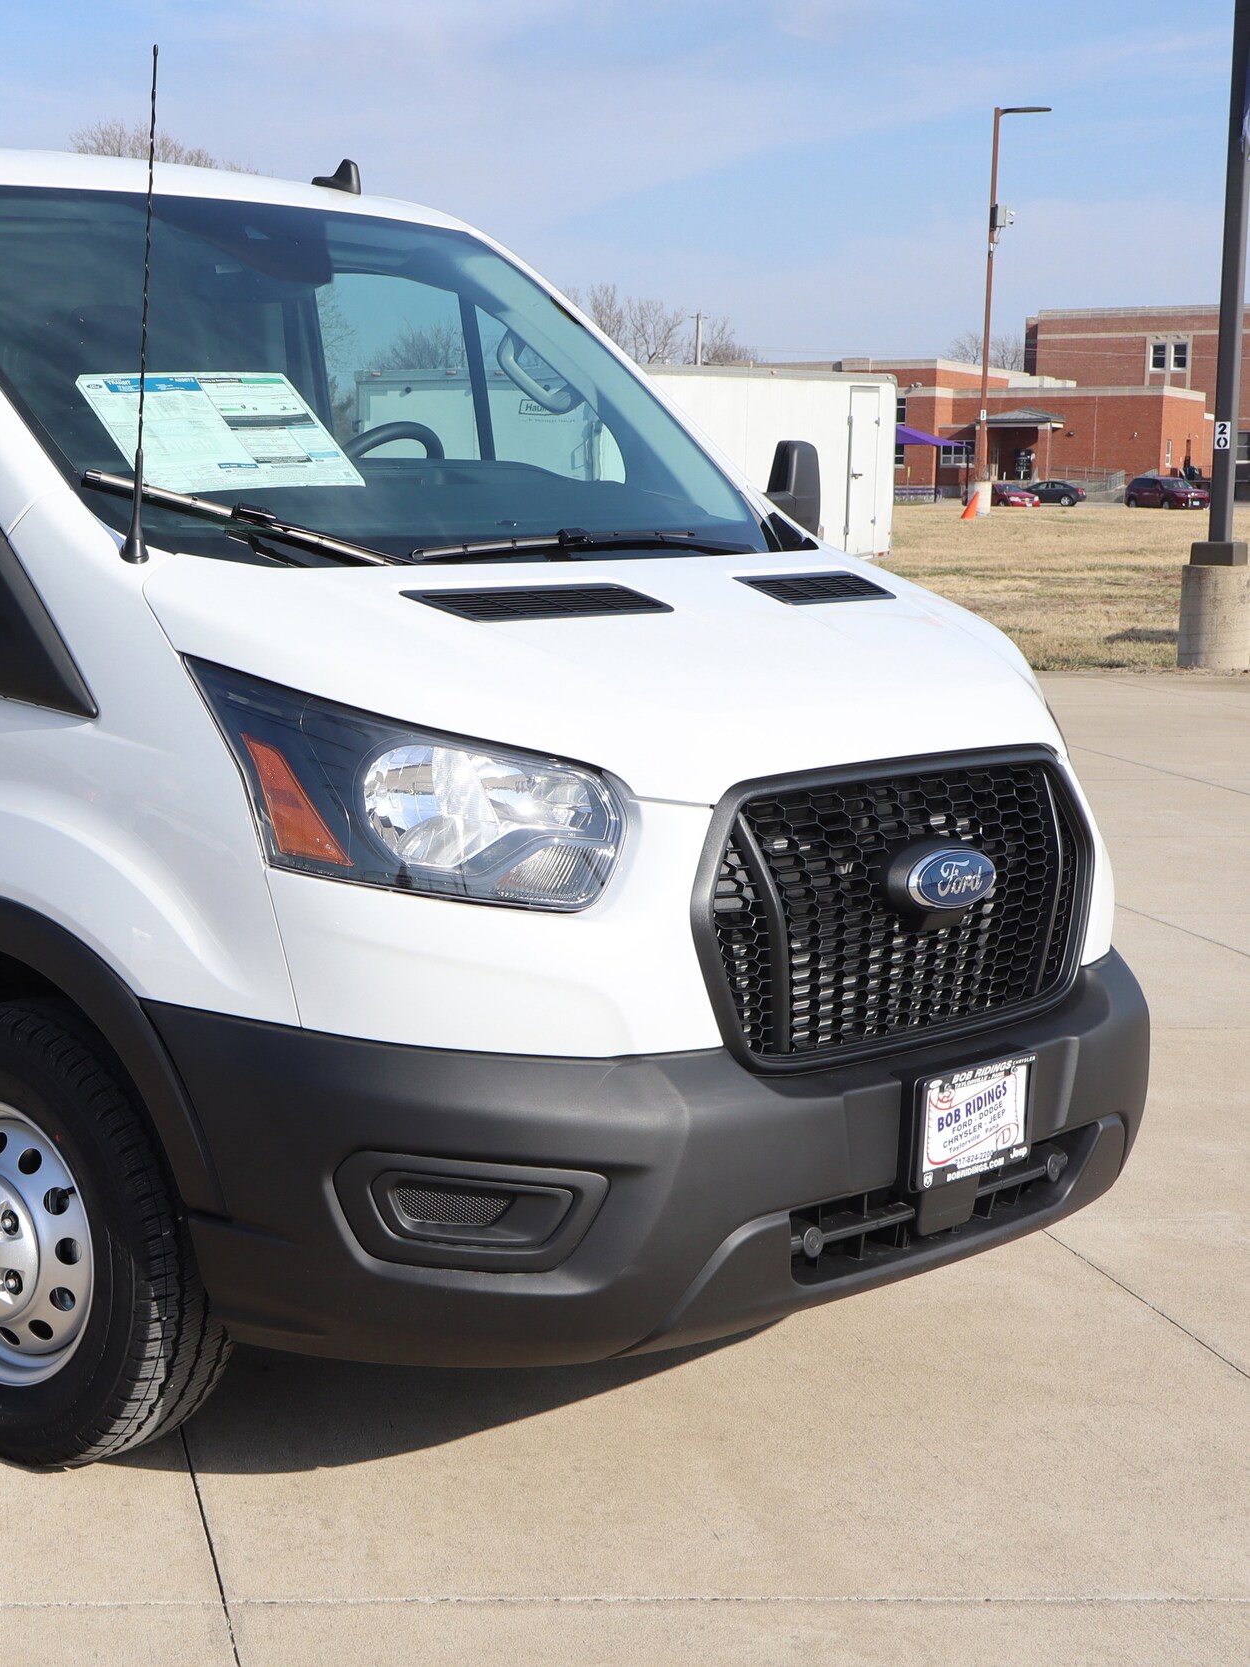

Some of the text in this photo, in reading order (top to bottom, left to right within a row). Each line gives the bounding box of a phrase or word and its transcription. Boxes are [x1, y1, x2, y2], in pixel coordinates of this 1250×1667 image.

[1216, 423, 1228, 448] 20
[937, 859, 983, 897] Ford
[952, 1070, 973, 1085] BOB
[974, 1060, 1013, 1078] RIDINGS
[1012, 1055, 1036, 1066] CHRYSLER
[954, 1076, 987, 1089] TAYLORVILLE
[937, 1080, 1008, 1133] BOB RIDINGS
[952, 1118, 973, 1135] FORD
[979, 1100, 1003, 1120] DODGE
[942, 1122, 983, 1149] CHRYSLER
[988, 1108, 1006, 1124] JEEP
[949, 1133, 981, 1154] Taylorville
[1010, 1146, 1028, 1159] Jeep
[946, 1156, 1005, 1182] BOBRIDINGS.COM
